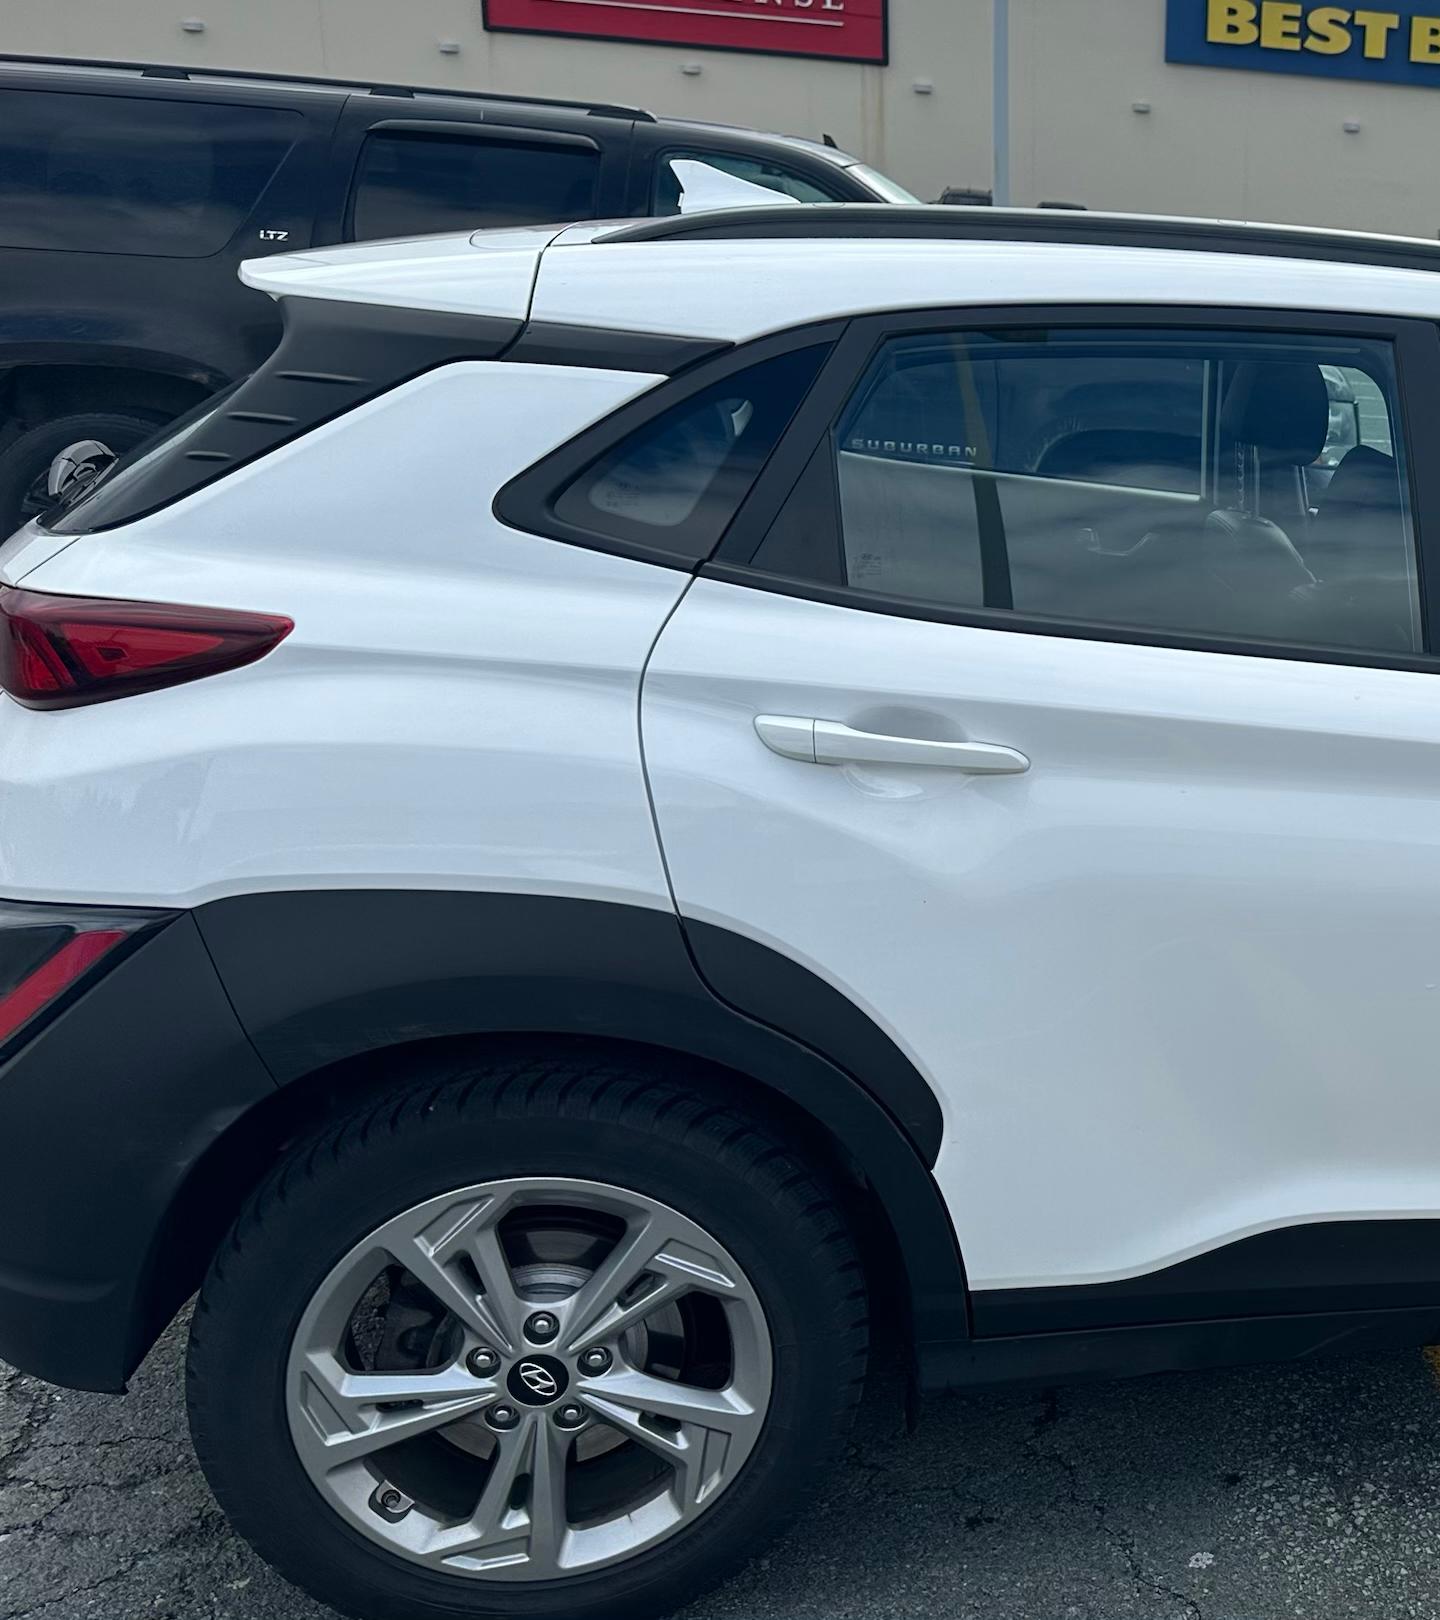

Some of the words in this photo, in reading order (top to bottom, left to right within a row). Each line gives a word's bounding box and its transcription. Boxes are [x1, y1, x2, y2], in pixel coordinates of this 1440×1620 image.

[1205, 0, 1400, 60] BEST
[259, 229, 289, 241] LTZ
[851, 438, 977, 457] SUBURBAN
